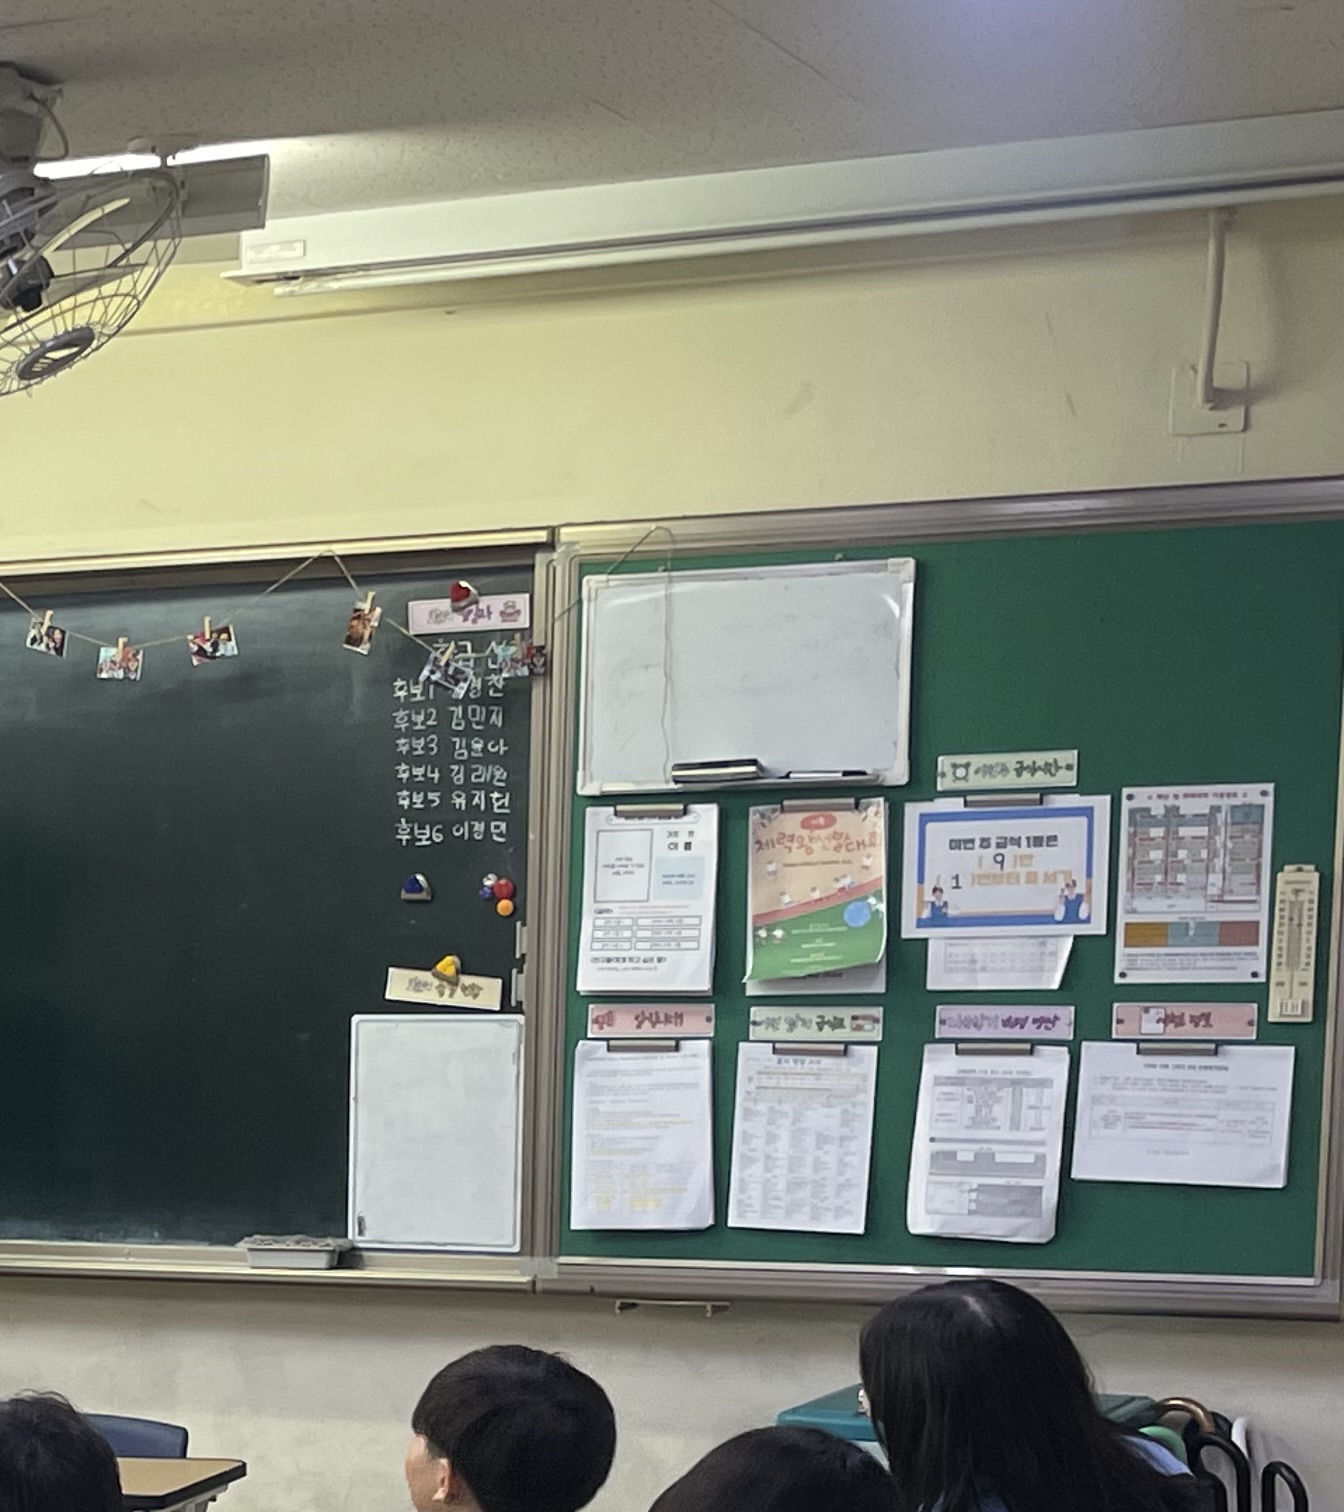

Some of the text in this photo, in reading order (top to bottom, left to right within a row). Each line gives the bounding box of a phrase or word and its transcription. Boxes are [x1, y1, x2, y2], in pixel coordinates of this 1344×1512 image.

[392, 705, 503, 732] 후보2 김민지
[395, 734, 438, 755] 후보3
[395, 762, 440, 784] 후보4
[396, 790, 441, 810] 후보5
[395, 818, 443, 846] 후보6
[993, 853, 1005, 870] 9
[951, 873, 962, 889] 1
